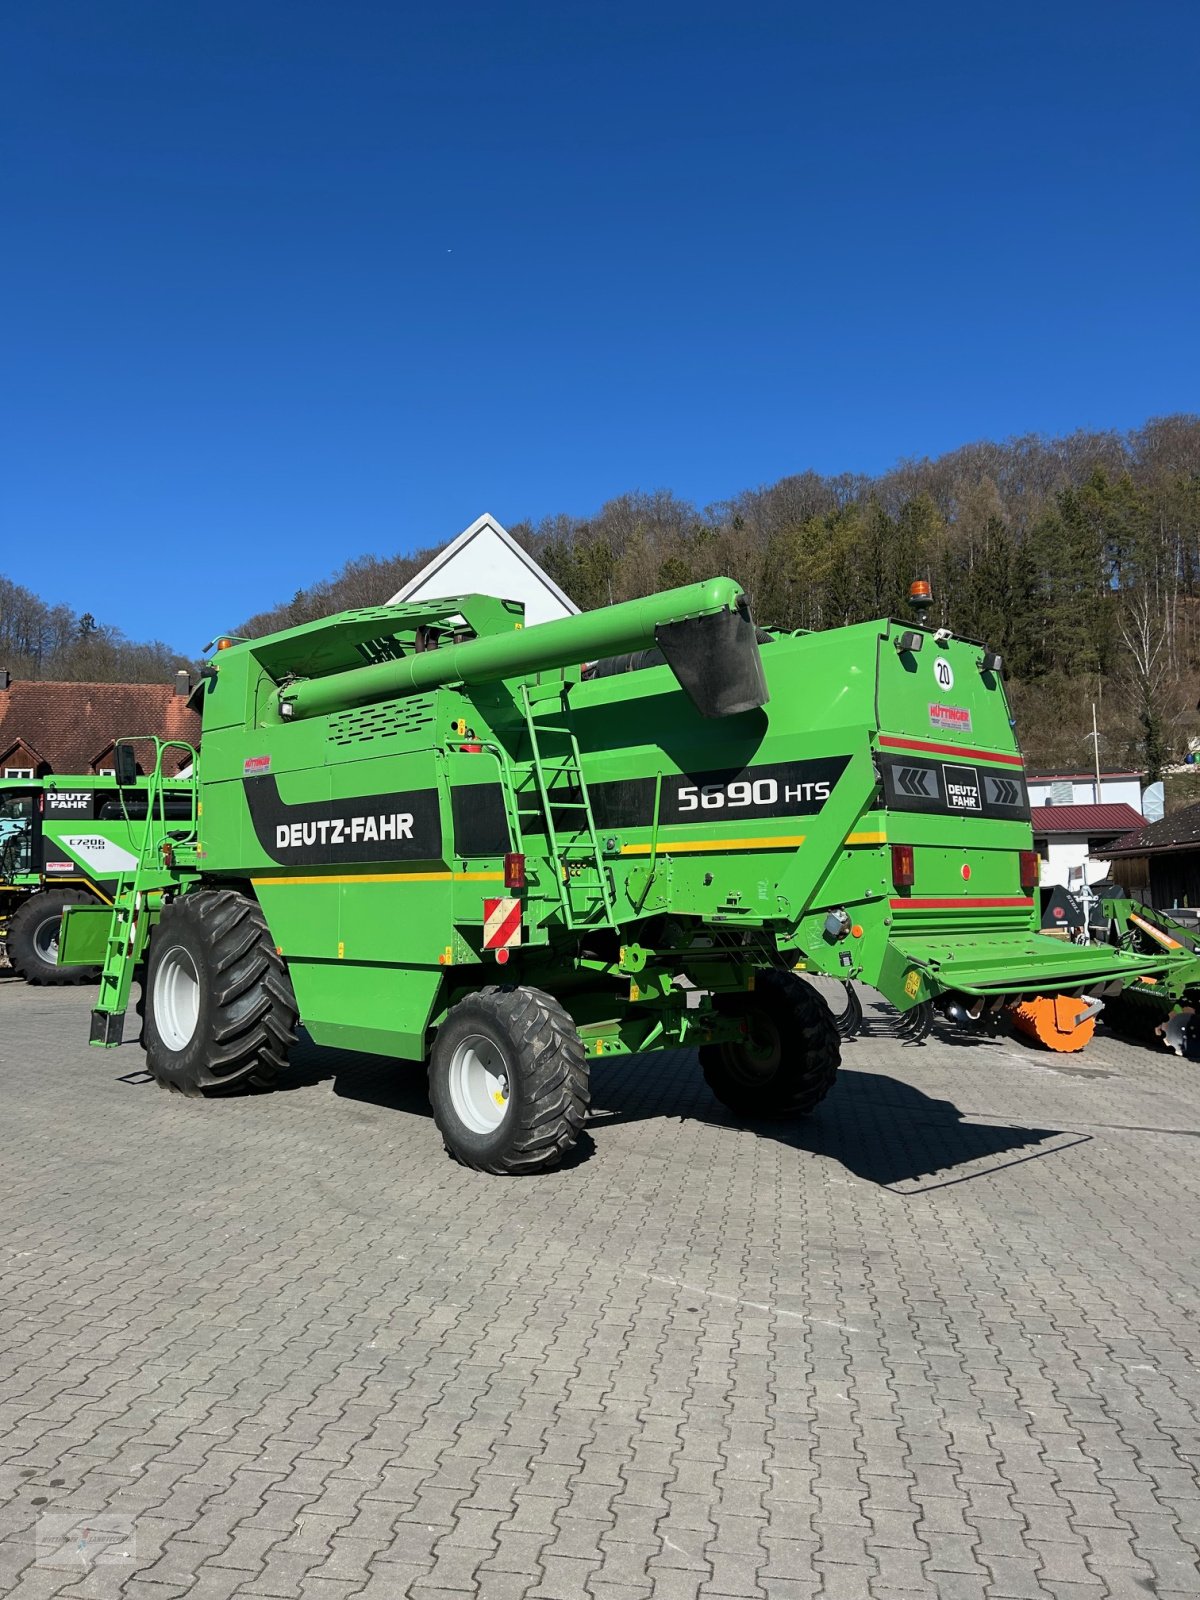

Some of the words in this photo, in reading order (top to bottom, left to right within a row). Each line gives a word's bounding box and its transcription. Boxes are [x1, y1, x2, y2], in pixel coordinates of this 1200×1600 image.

[937, 662, 950, 685] 20
[46, 793, 92, 801] DEUTZ
[677, 778, 778, 812] 5690
[785, 781, 830, 803] HTS
[948, 784, 978, 797] DEUTZ
[50, 801, 88, 809] FAHR
[952, 795, 976, 807] FAHR
[276, 812, 414, 849] DEUTZ-FAHR
